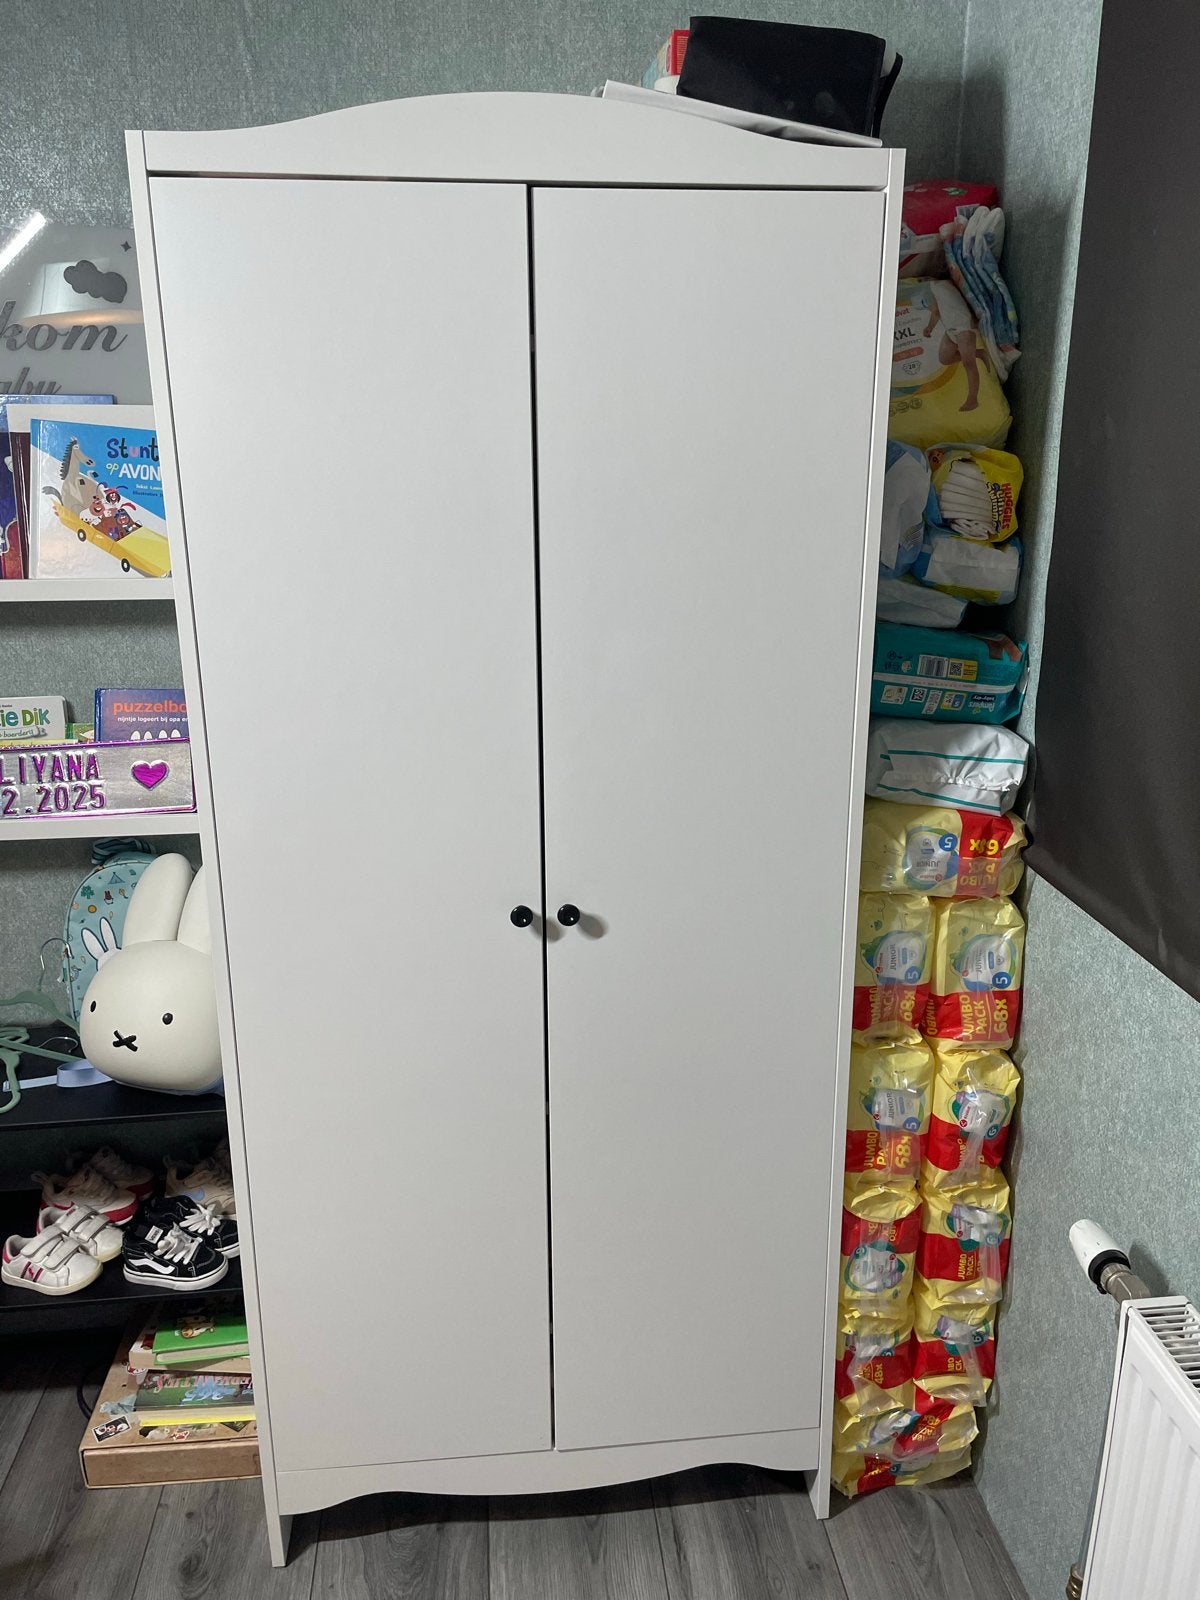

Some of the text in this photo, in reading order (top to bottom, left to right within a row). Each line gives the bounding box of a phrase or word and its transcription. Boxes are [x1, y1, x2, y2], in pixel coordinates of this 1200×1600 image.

[106, 437, 159, 462] Stunt
[106, 463, 162, 481] op AVON
[1001, 482, 1014, 530] HUGGIES
[21, 707, 51, 727] Dik
[2, 780, 106, 816] 2.2025
[944, 836, 953, 848] 5
[907, 970, 919, 981] 5
[995, 976, 1008, 985] 5
[960, 994, 974, 1040] JUMBO
[974, 1000, 988, 1034] PACK
[993, 998, 1008, 1034] 68x
[887, 1091, 895, 1120] JUNIOR
[905, 1122, 917, 1130] 5
[863, 1131, 878, 1168] JUMBO
[957, 1253, 966, 1280] JUMBO
[966, 1255, 974, 1276] PACK
[874, 1362, 884, 1385] 48x
